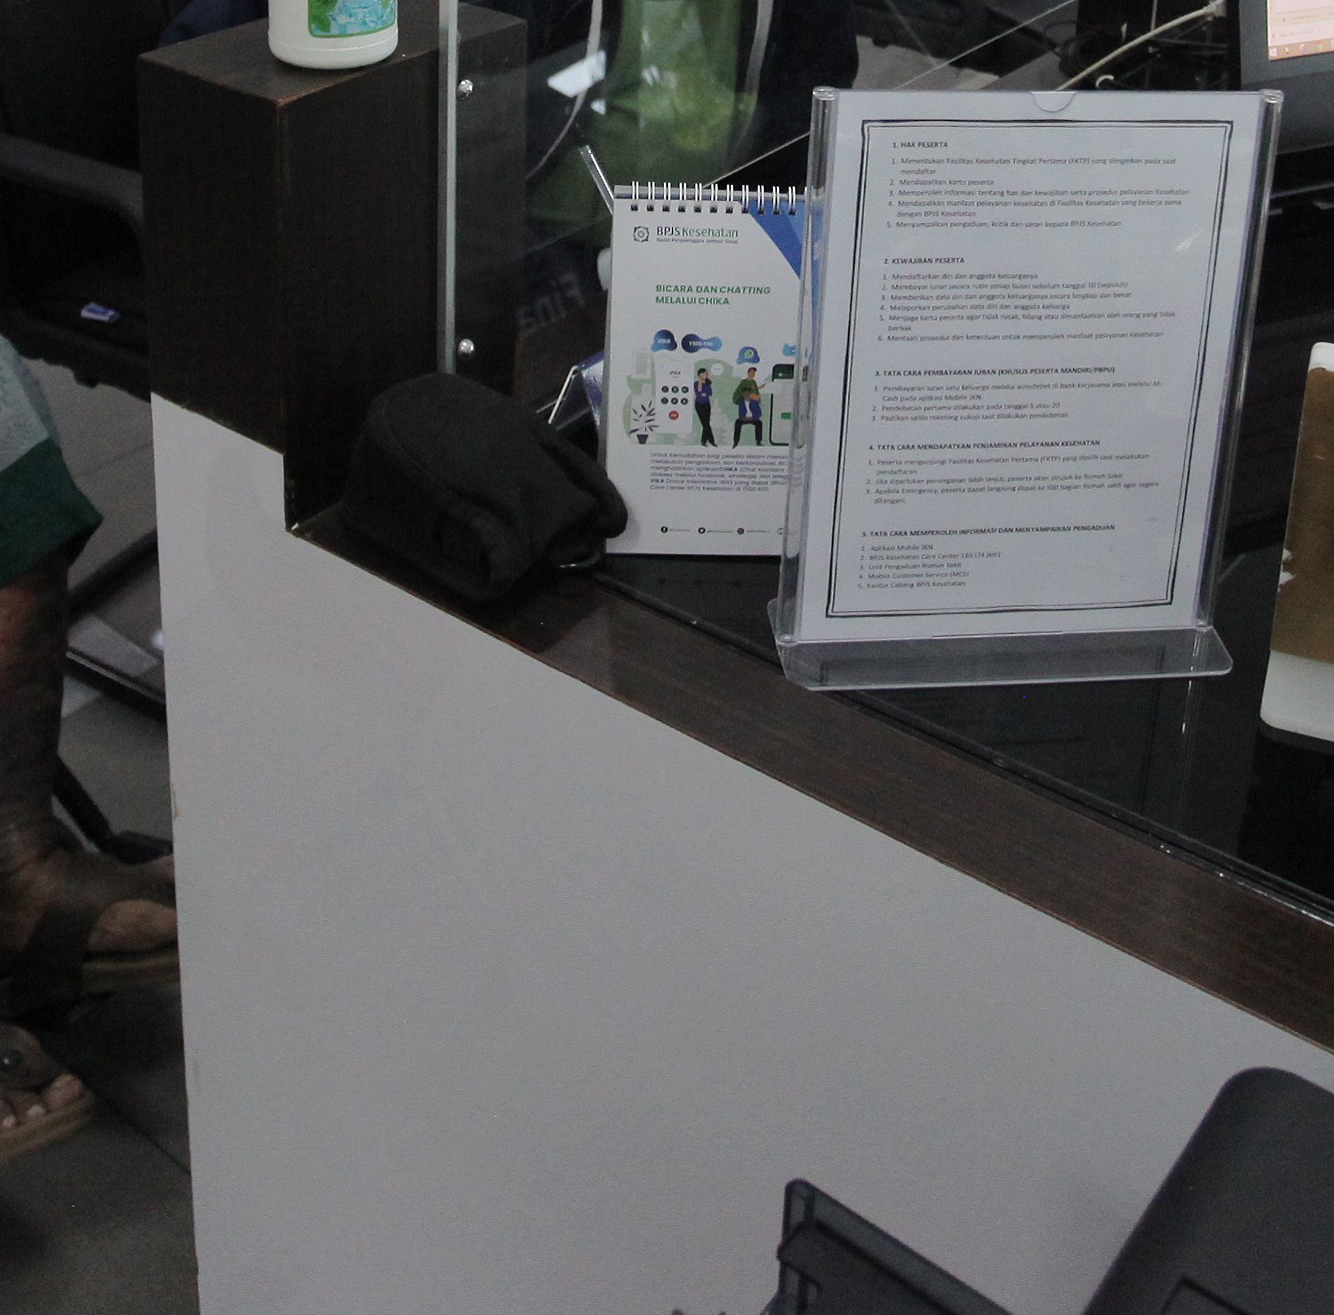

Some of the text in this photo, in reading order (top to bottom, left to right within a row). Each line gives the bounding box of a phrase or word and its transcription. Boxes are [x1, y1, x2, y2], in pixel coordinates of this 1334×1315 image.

[656, 226, 738, 238] BPJS Kesehatan
[656, 284, 772, 294] BICARA DAN CHATTING
[656, 296, 730, 305] MELALUI CHIKA
[916, 442, 971, 450] MENDAPATKAN
[908, 528, 957, 536] MEMPEROLEH
[958, 527, 997, 535] INFORMASI
[1014, 525, 1071, 534] MENYAMPAIKAN
[1072, 524, 1115, 532] PENGADUAN
